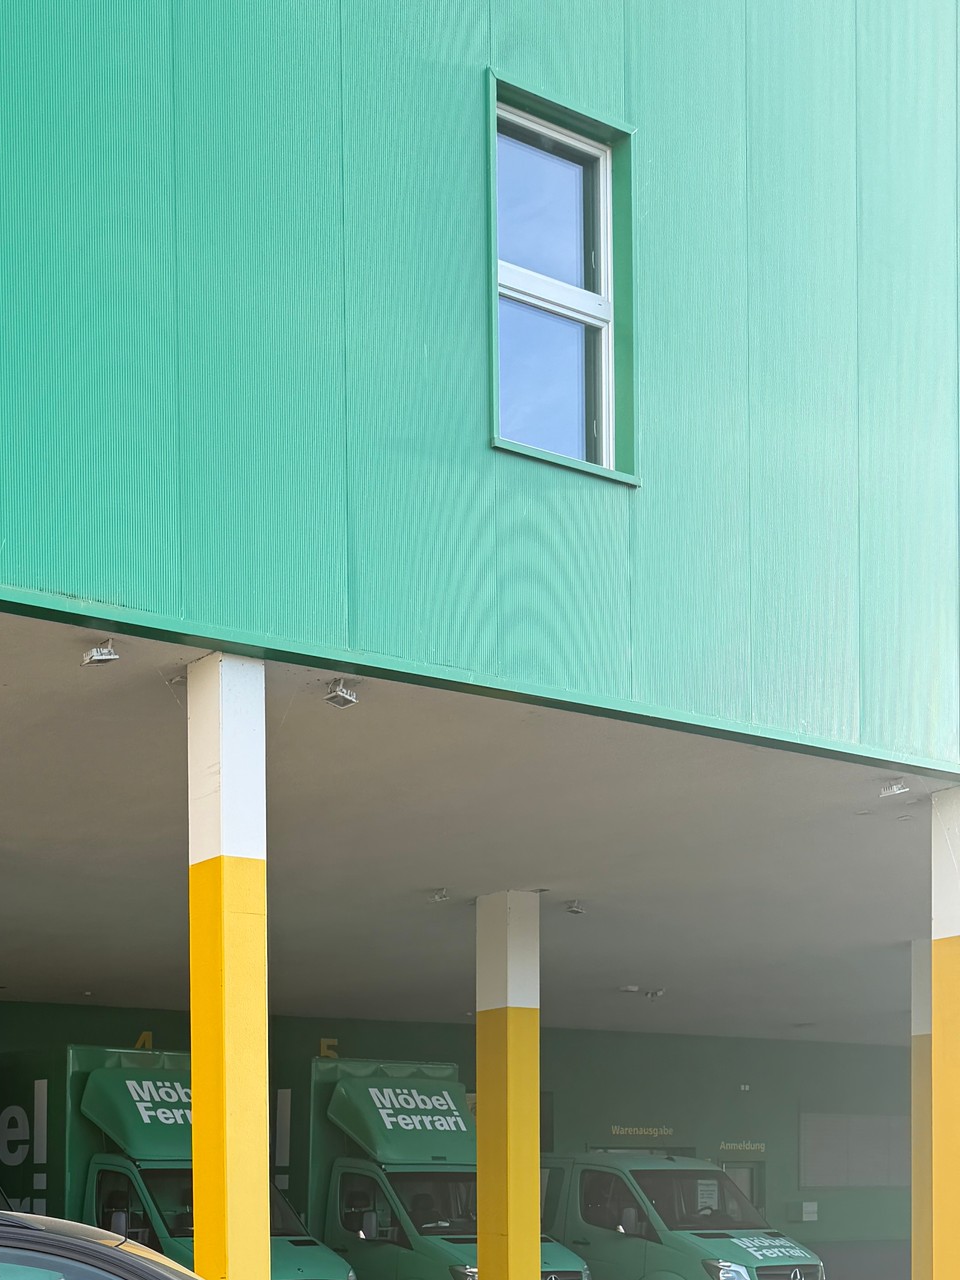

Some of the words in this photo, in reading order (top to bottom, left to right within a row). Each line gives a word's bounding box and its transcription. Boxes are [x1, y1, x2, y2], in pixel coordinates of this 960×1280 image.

[126, 1080, 192, 1103] Möb
[368, 1087, 457, 1110] Möbel
[378, 1109, 467, 1132] Ferrari
[611, 1125, 674, 1137] Warenausgabe
[719, 1141, 766, 1152] Anmeldung
[730, 1237, 796, 1249] Möbel
[746, 1247, 811, 1260] Ferrari
